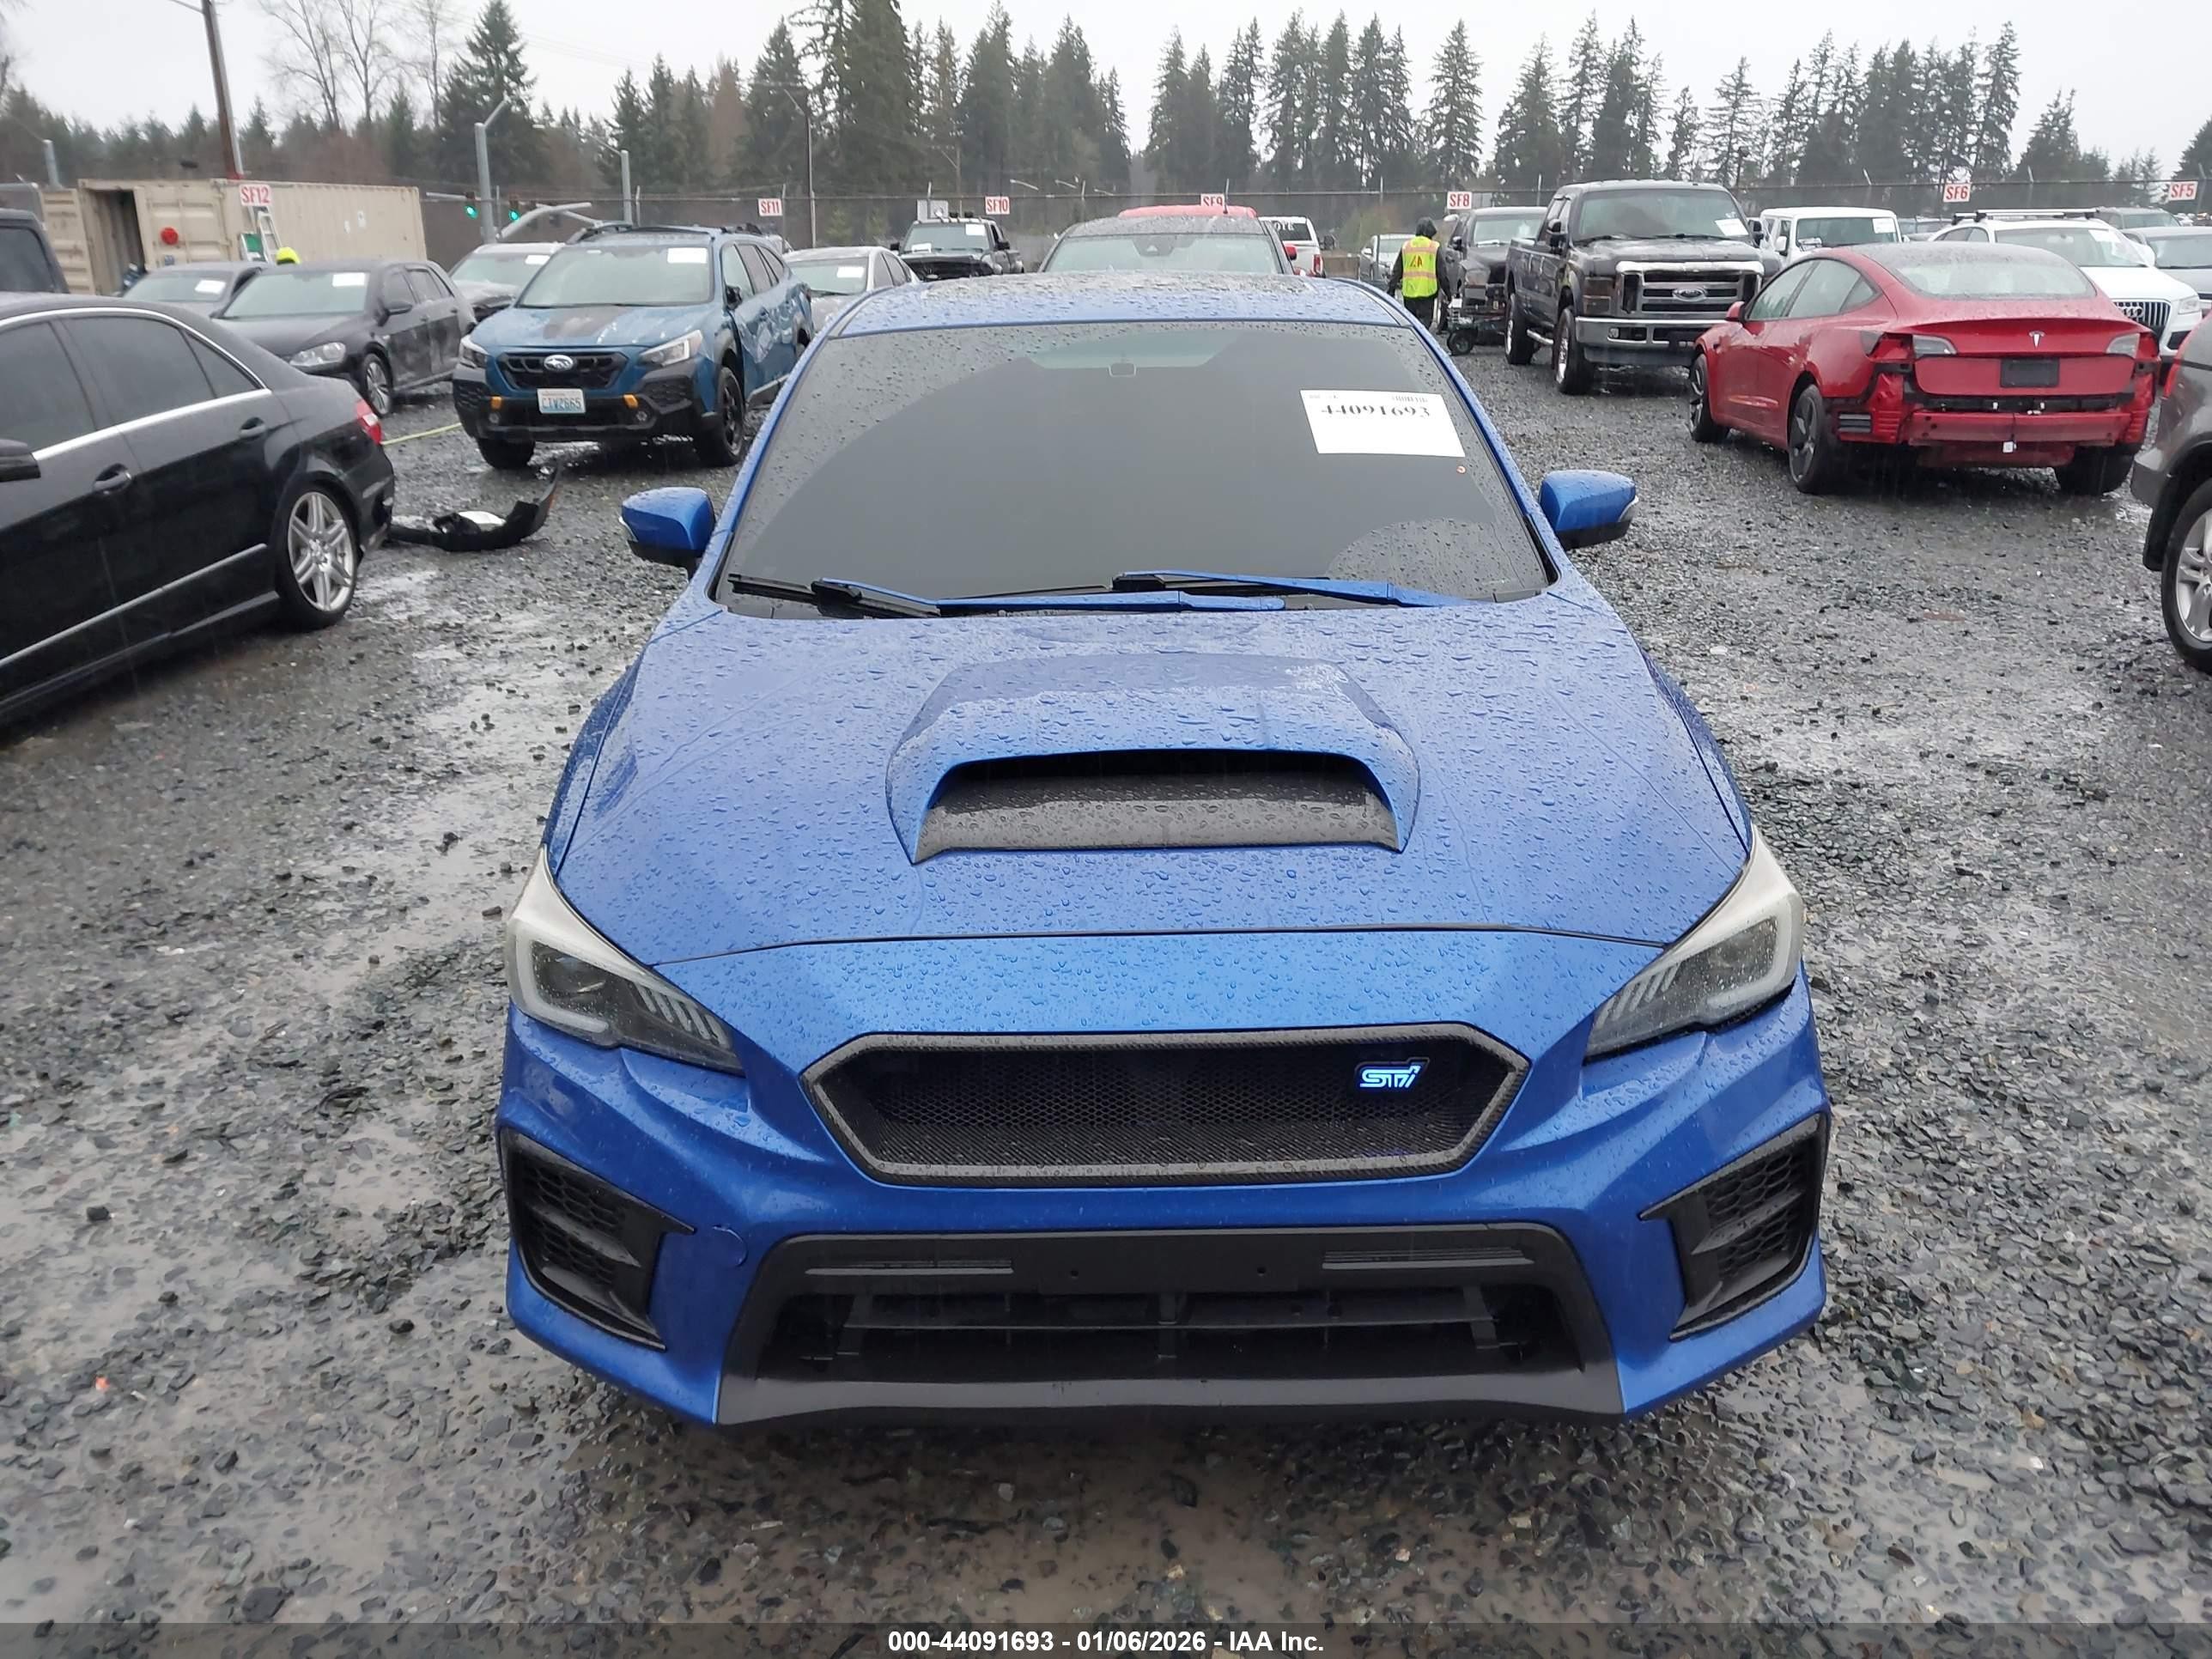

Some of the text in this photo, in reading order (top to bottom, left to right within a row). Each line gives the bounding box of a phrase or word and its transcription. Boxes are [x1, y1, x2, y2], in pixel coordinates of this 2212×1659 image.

[240, 185, 270, 204] SF12
[1946, 185, 1968, 199] SF6
[2171, 184, 2194, 198] SF5
[761, 200, 779, 214] SF11
[987, 198, 1008, 212] SF10
[1203, 196, 1223, 206] SF9
[1449, 193, 1470, 207] SF8
[1321, 404, 1431, 418] 44091693
